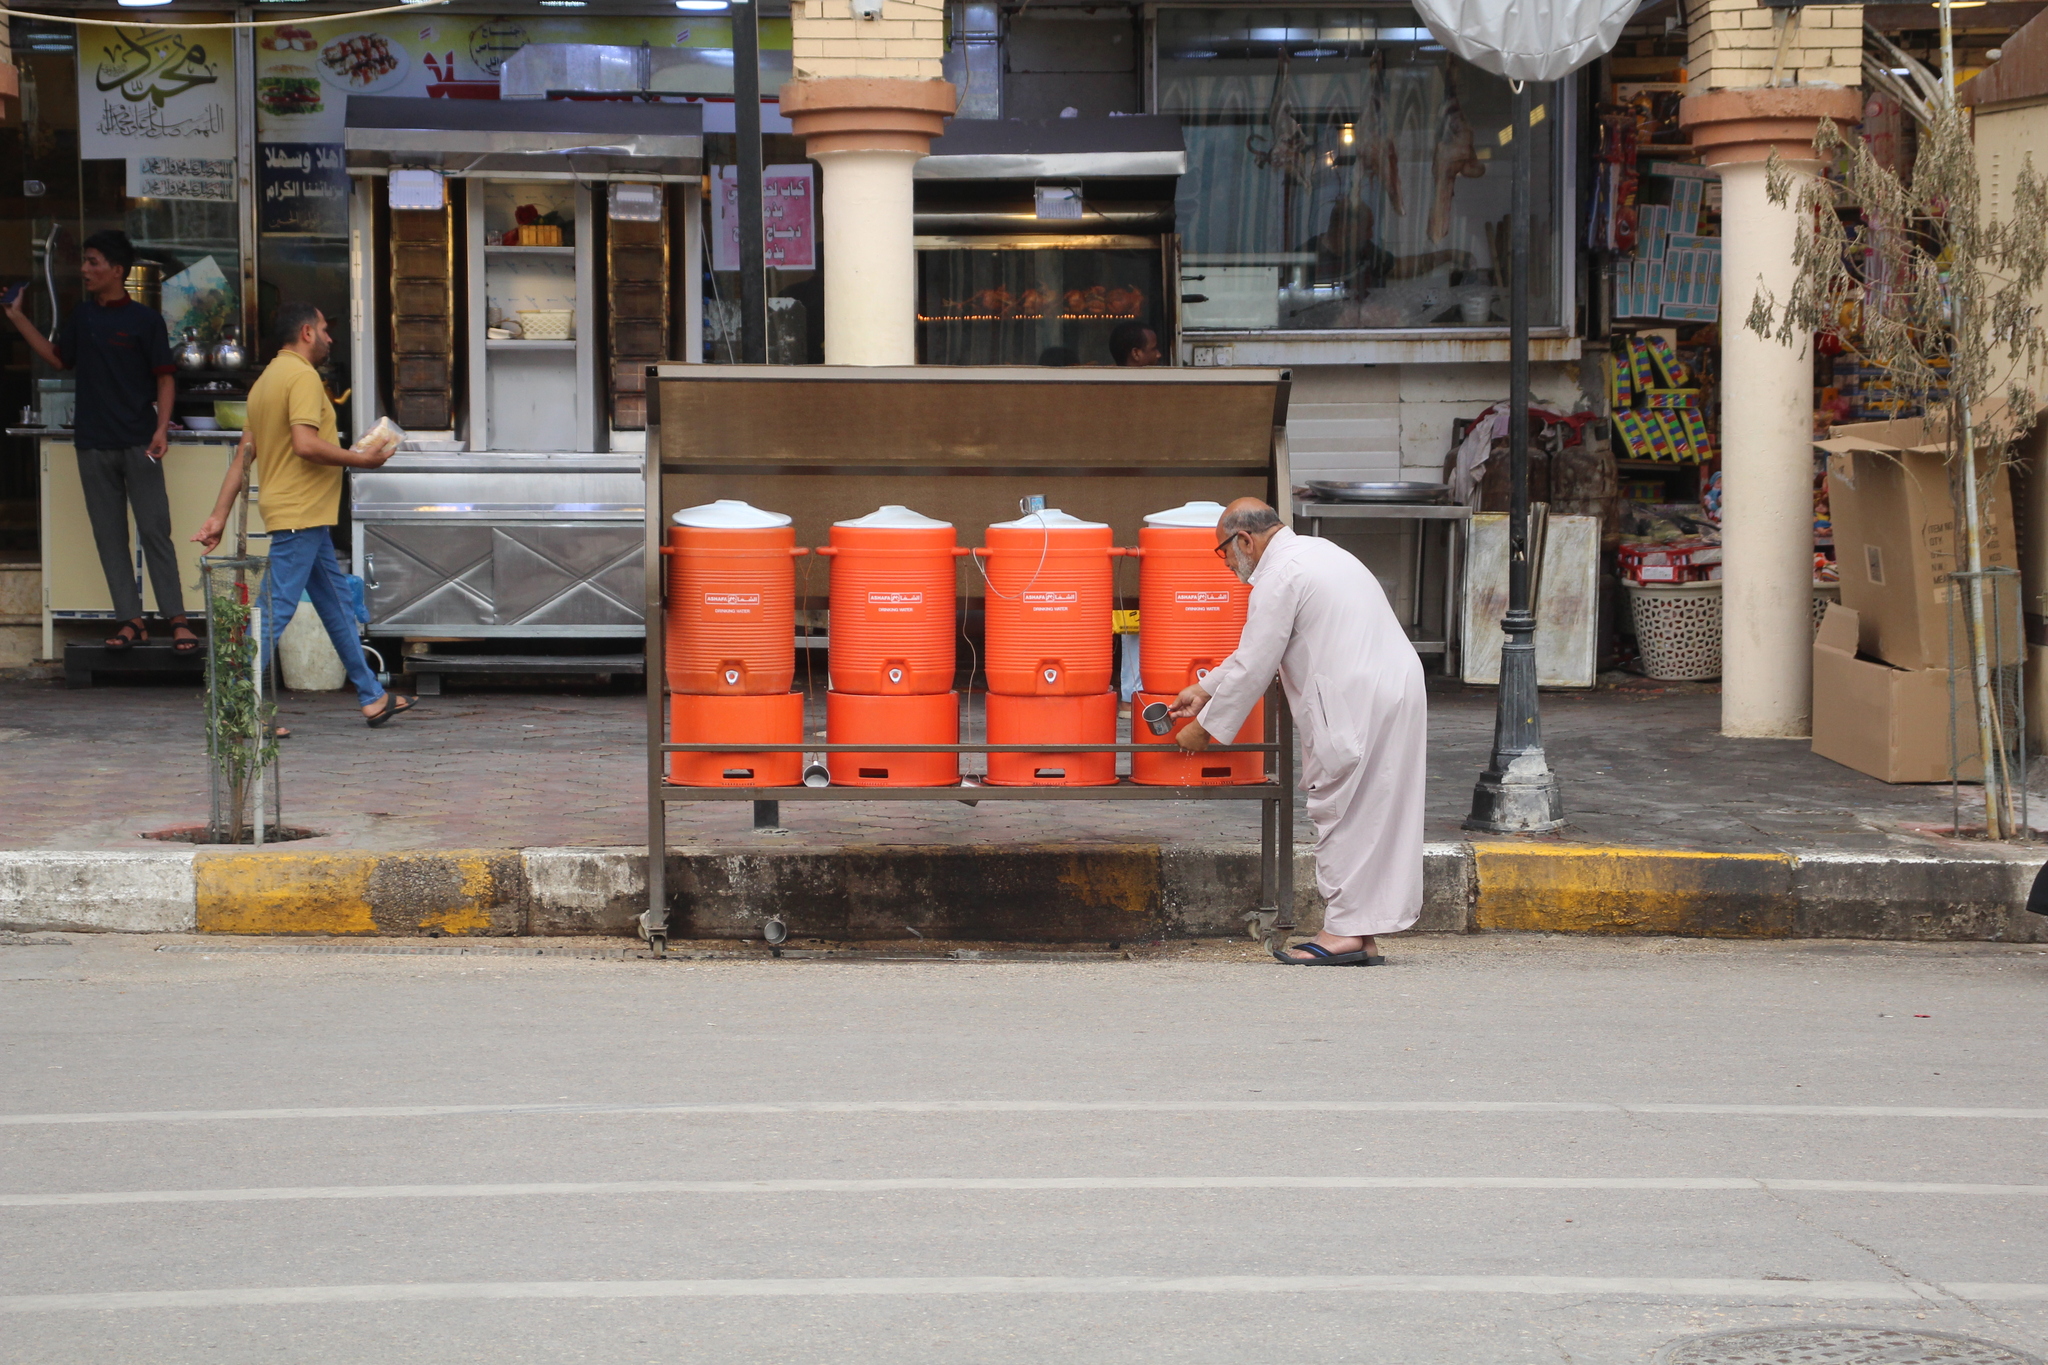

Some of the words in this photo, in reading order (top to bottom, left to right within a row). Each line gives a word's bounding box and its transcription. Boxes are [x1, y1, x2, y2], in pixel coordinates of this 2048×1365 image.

[96, 26, 218, 109] محمد
[266, 181, 299, 202] الكرام
[781, 180, 805, 200] كباب
[766, 222, 802, 242] دجاج
